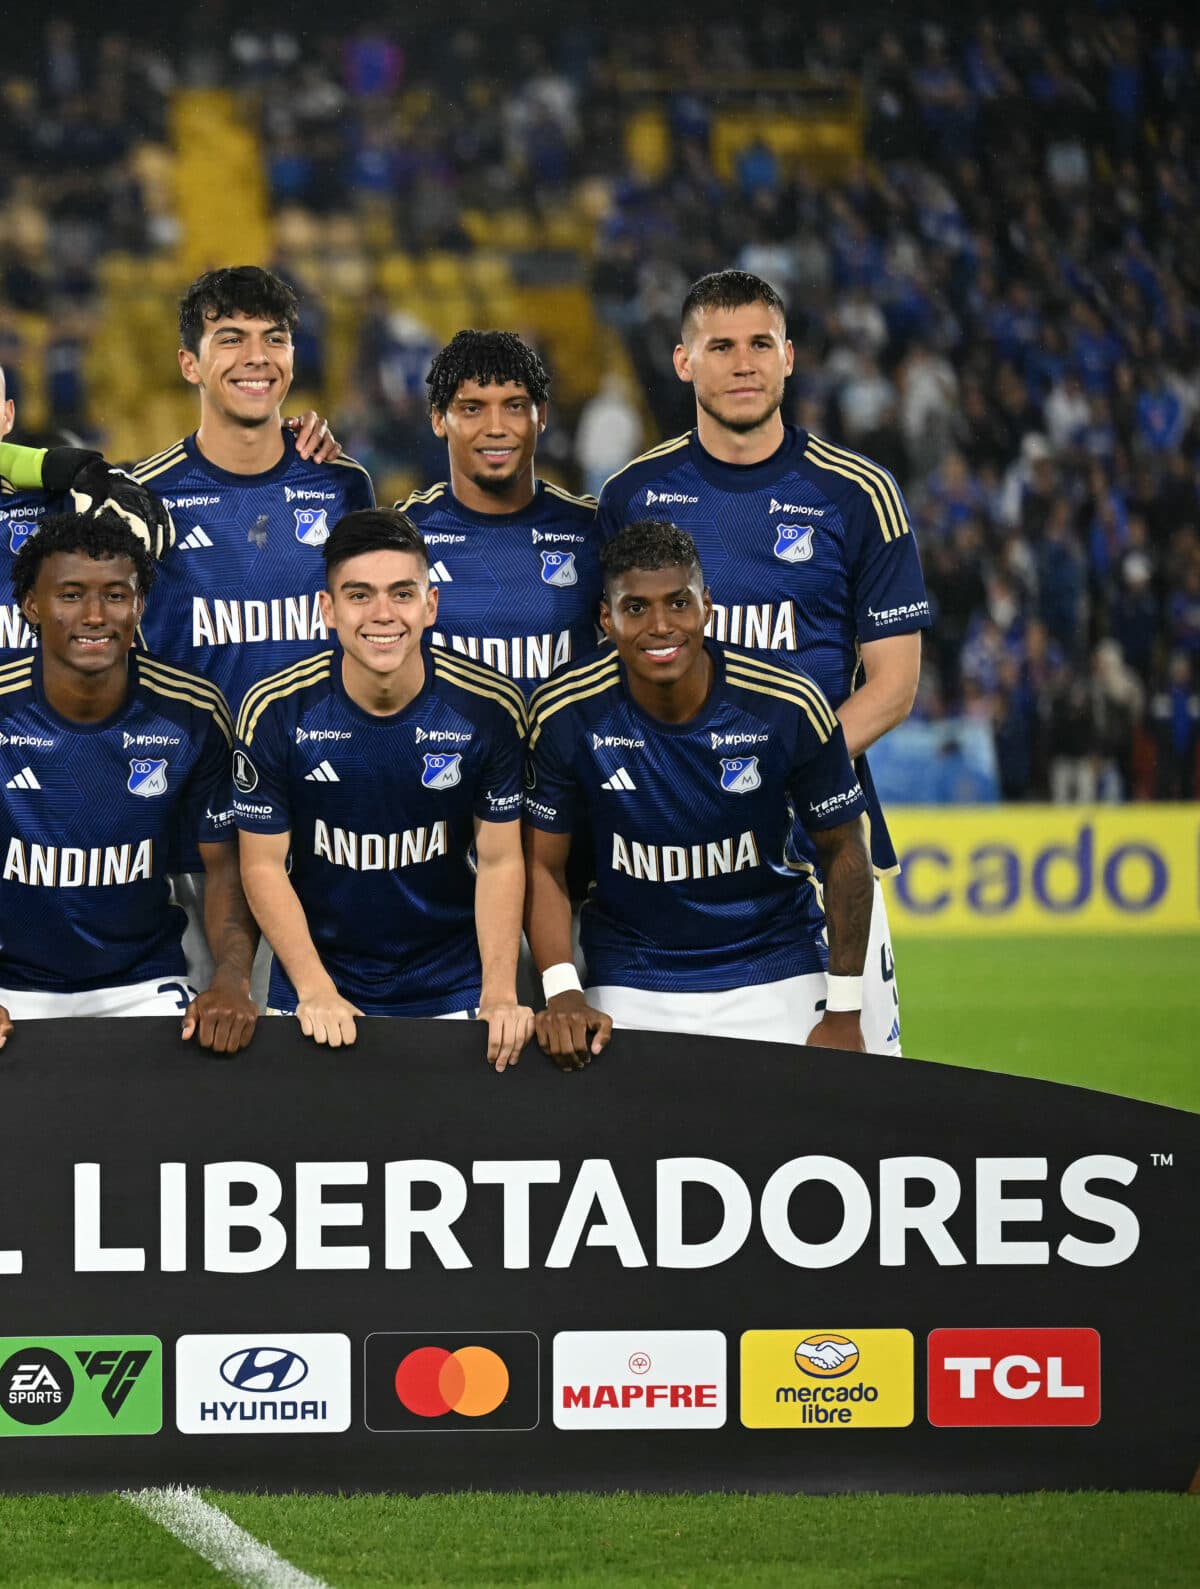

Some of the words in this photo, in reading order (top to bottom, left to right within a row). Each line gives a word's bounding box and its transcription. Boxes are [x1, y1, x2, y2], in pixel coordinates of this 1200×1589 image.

[10, 734, 54, 747] Wplay.co
[136, 734, 180, 746] Wplay.co
[310, 729, 352, 742] Wplay.co
[429, 729, 472, 742] Wplay.co
[314, 818, 447, 872] ANDINA
[3, 837, 153, 888] ANDINA
[611, 829, 761, 883] ANDINA
[74, 1154, 1140, 1274] LIBERTADORES
[9, 1364, 61, 1391] EA
[944, 1354, 1084, 1400] TCL
[9, 1391, 62, 1404] SPORTS
[563, 1384, 717, 1409] MAPFRE
[776, 1382, 878, 1403] mercado
[200, 1400, 327, 1421] HYUNDAI
[802, 1403, 852, 1424] libre
